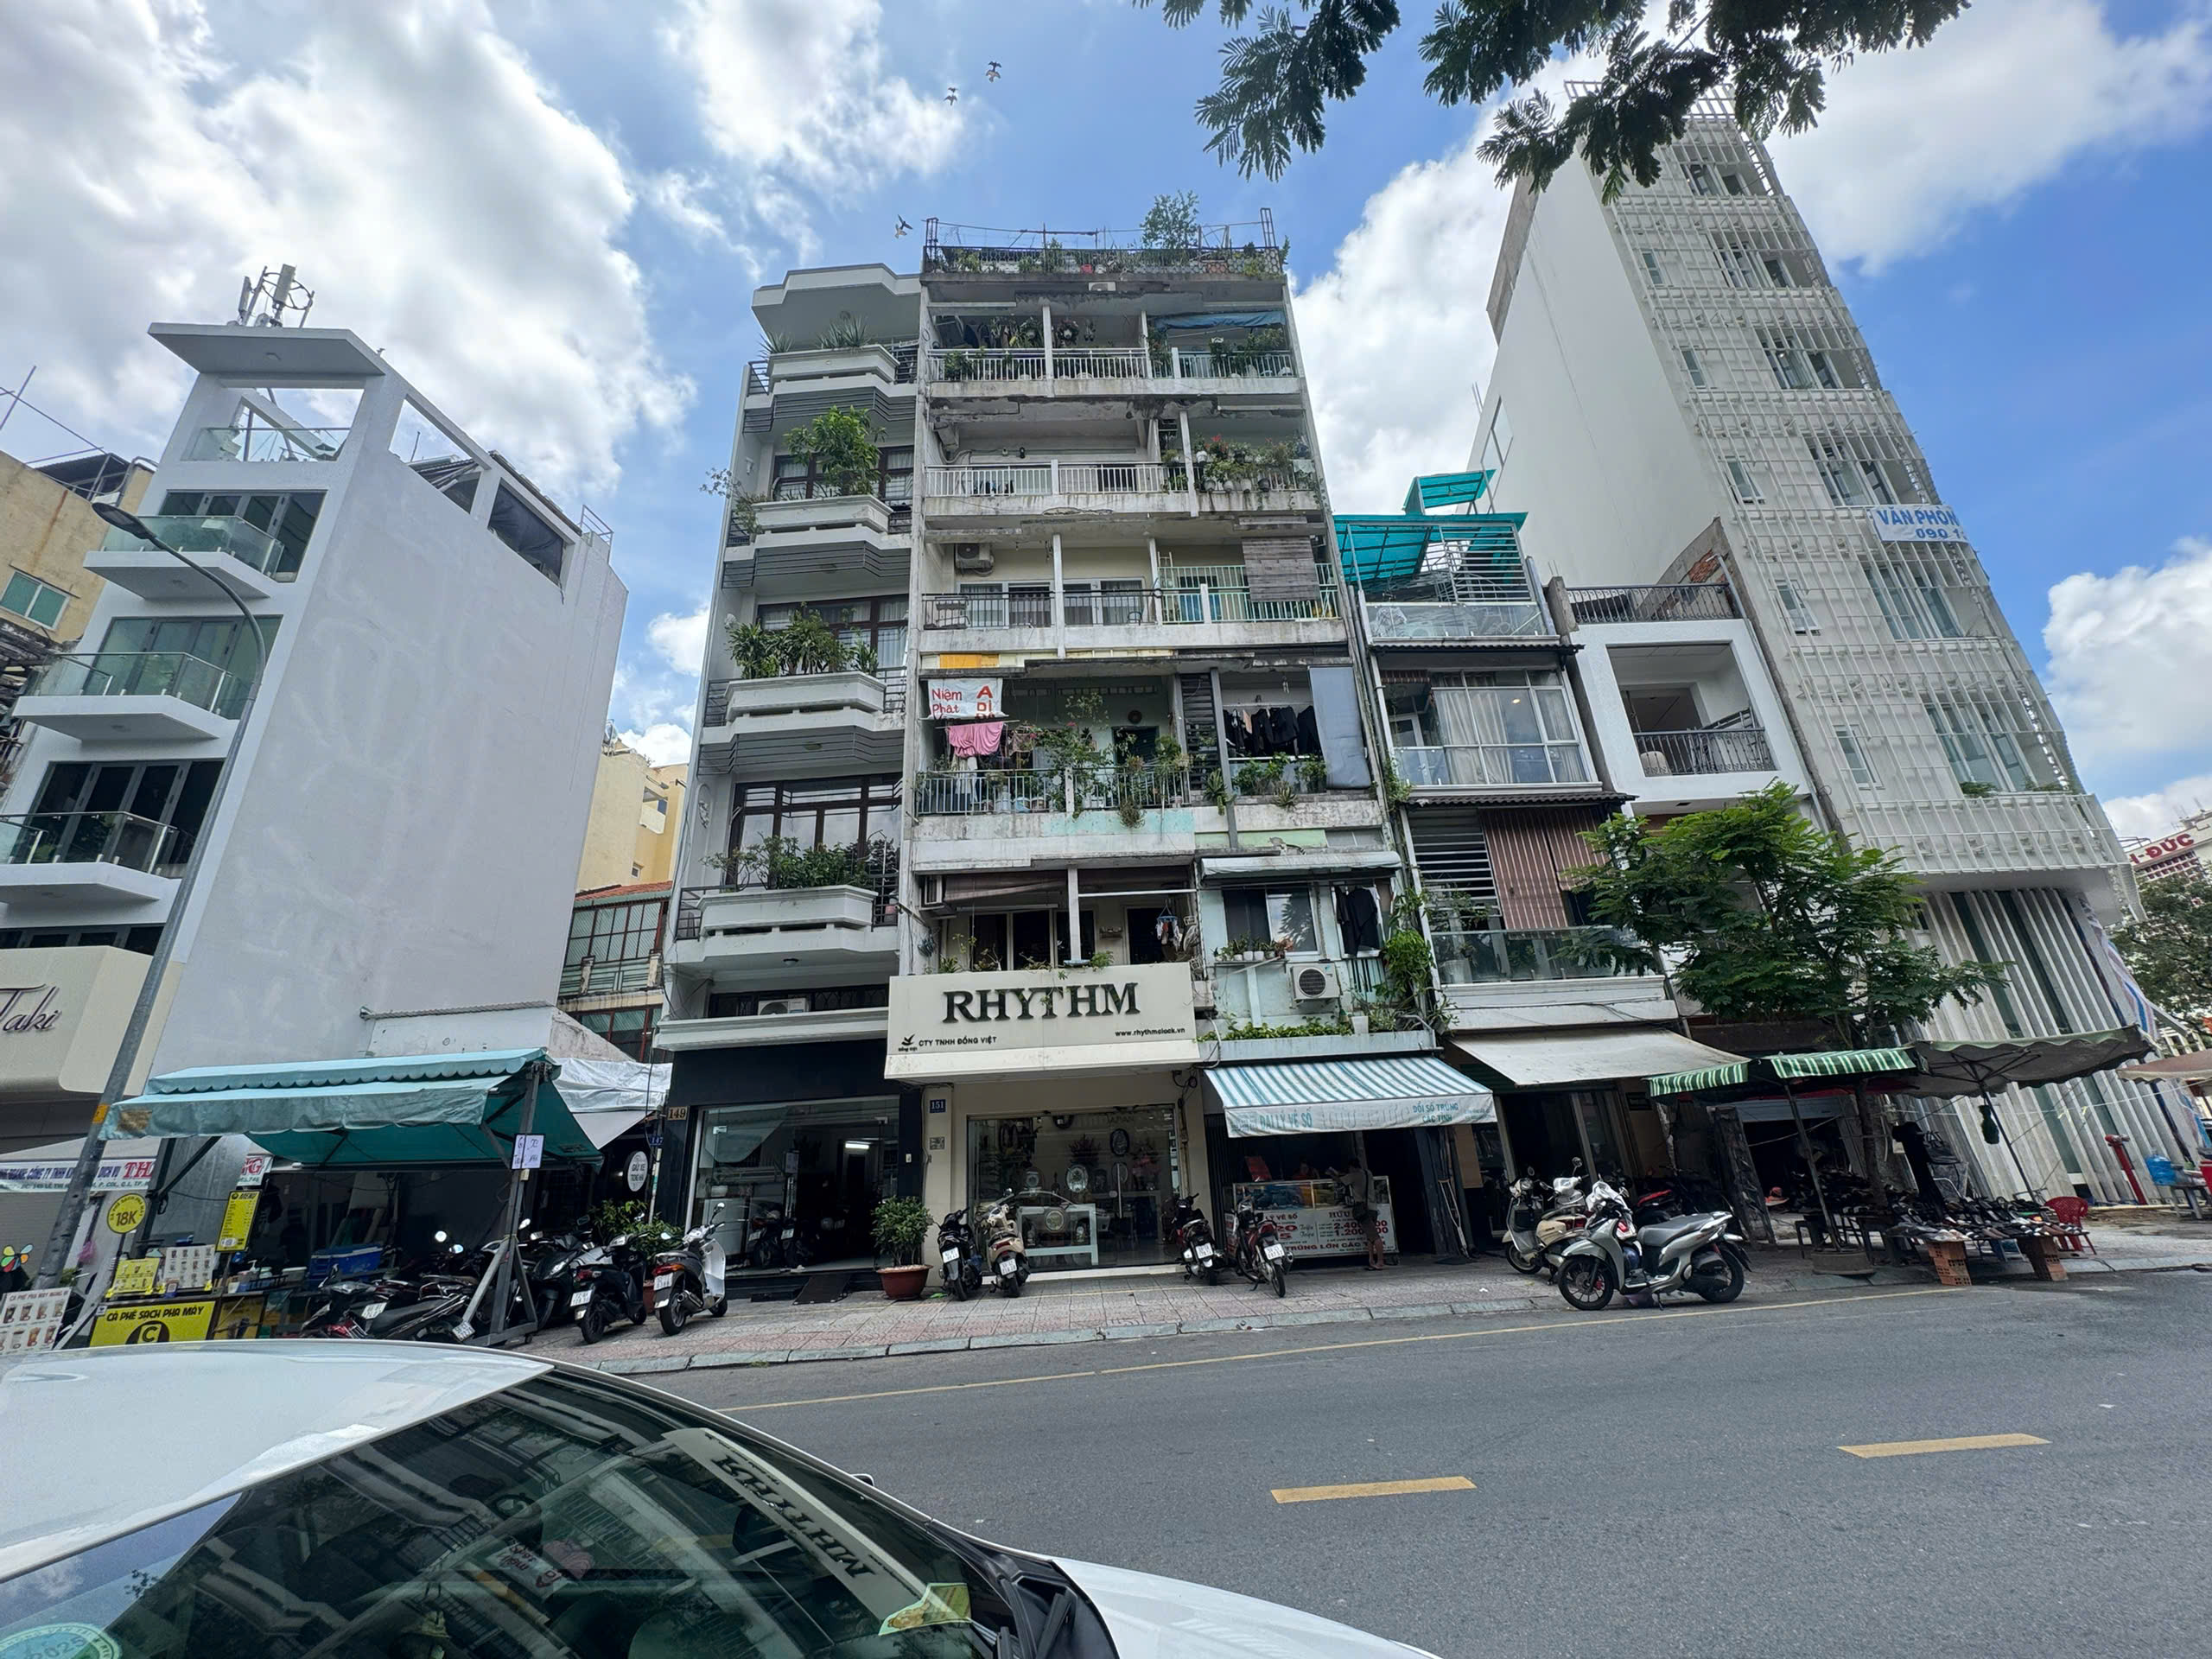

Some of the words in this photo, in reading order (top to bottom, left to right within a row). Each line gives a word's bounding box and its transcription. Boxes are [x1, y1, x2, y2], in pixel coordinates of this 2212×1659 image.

[1876, 505, 1915, 524] VĂN
[931, 688, 963, 702] Niệm
[976, 684, 994, 699] A
[942, 982, 1141, 1024] RHYTHM
[1115, 1027, 1185, 1037] www.rhythmclock.vn
[935, 1038, 956, 1046] TNHH
[980, 1035, 997, 1045] VIỆT
[931, 1101, 944, 1109] 151
[669, 1108, 686, 1120] 149
[116, 1211, 137, 1227] 18K
